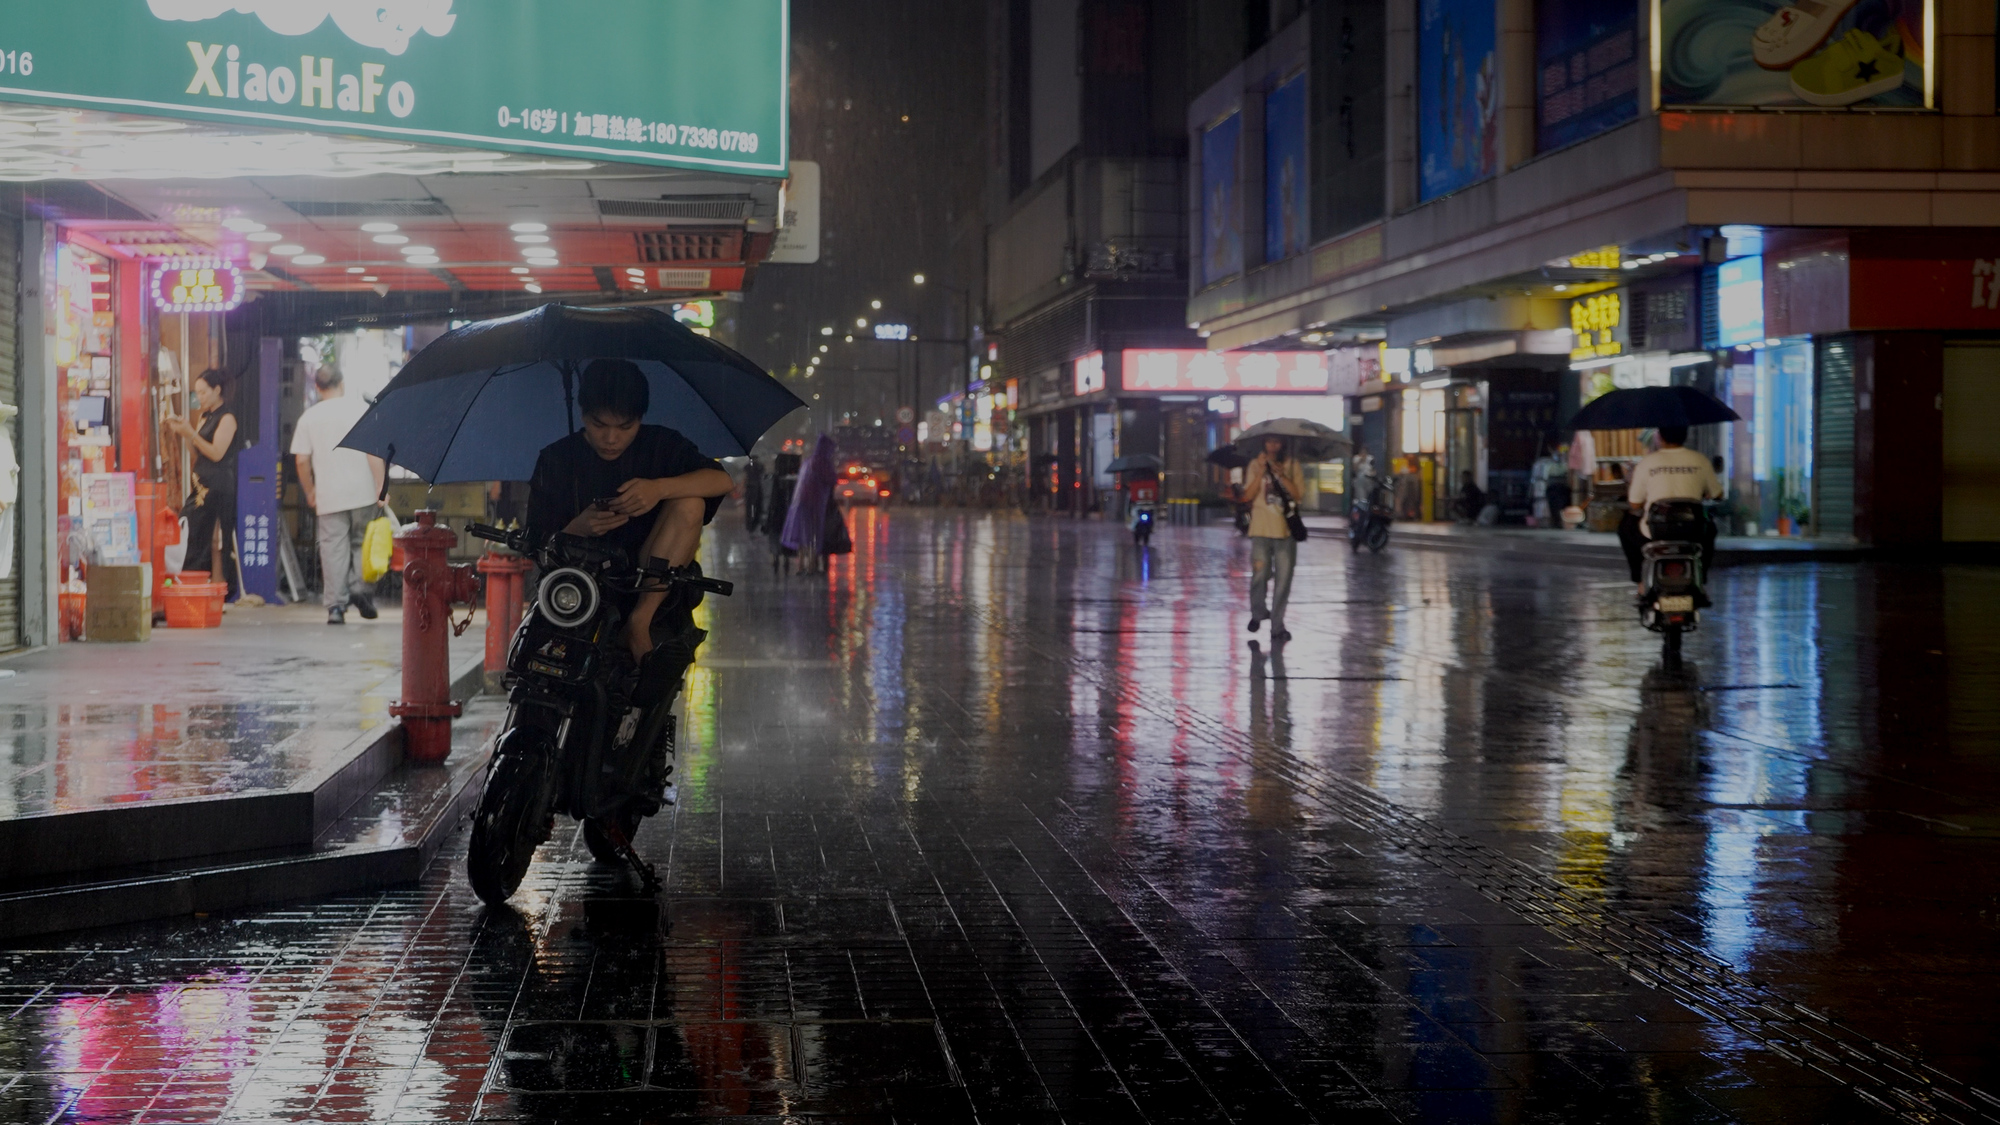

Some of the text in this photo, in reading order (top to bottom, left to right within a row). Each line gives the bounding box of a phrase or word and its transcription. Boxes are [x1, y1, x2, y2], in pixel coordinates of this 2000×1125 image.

[185, 41, 415, 118] XiaoHaFo
[679, 125, 718, 149] 7336
[720, 130, 758, 153] 0789
